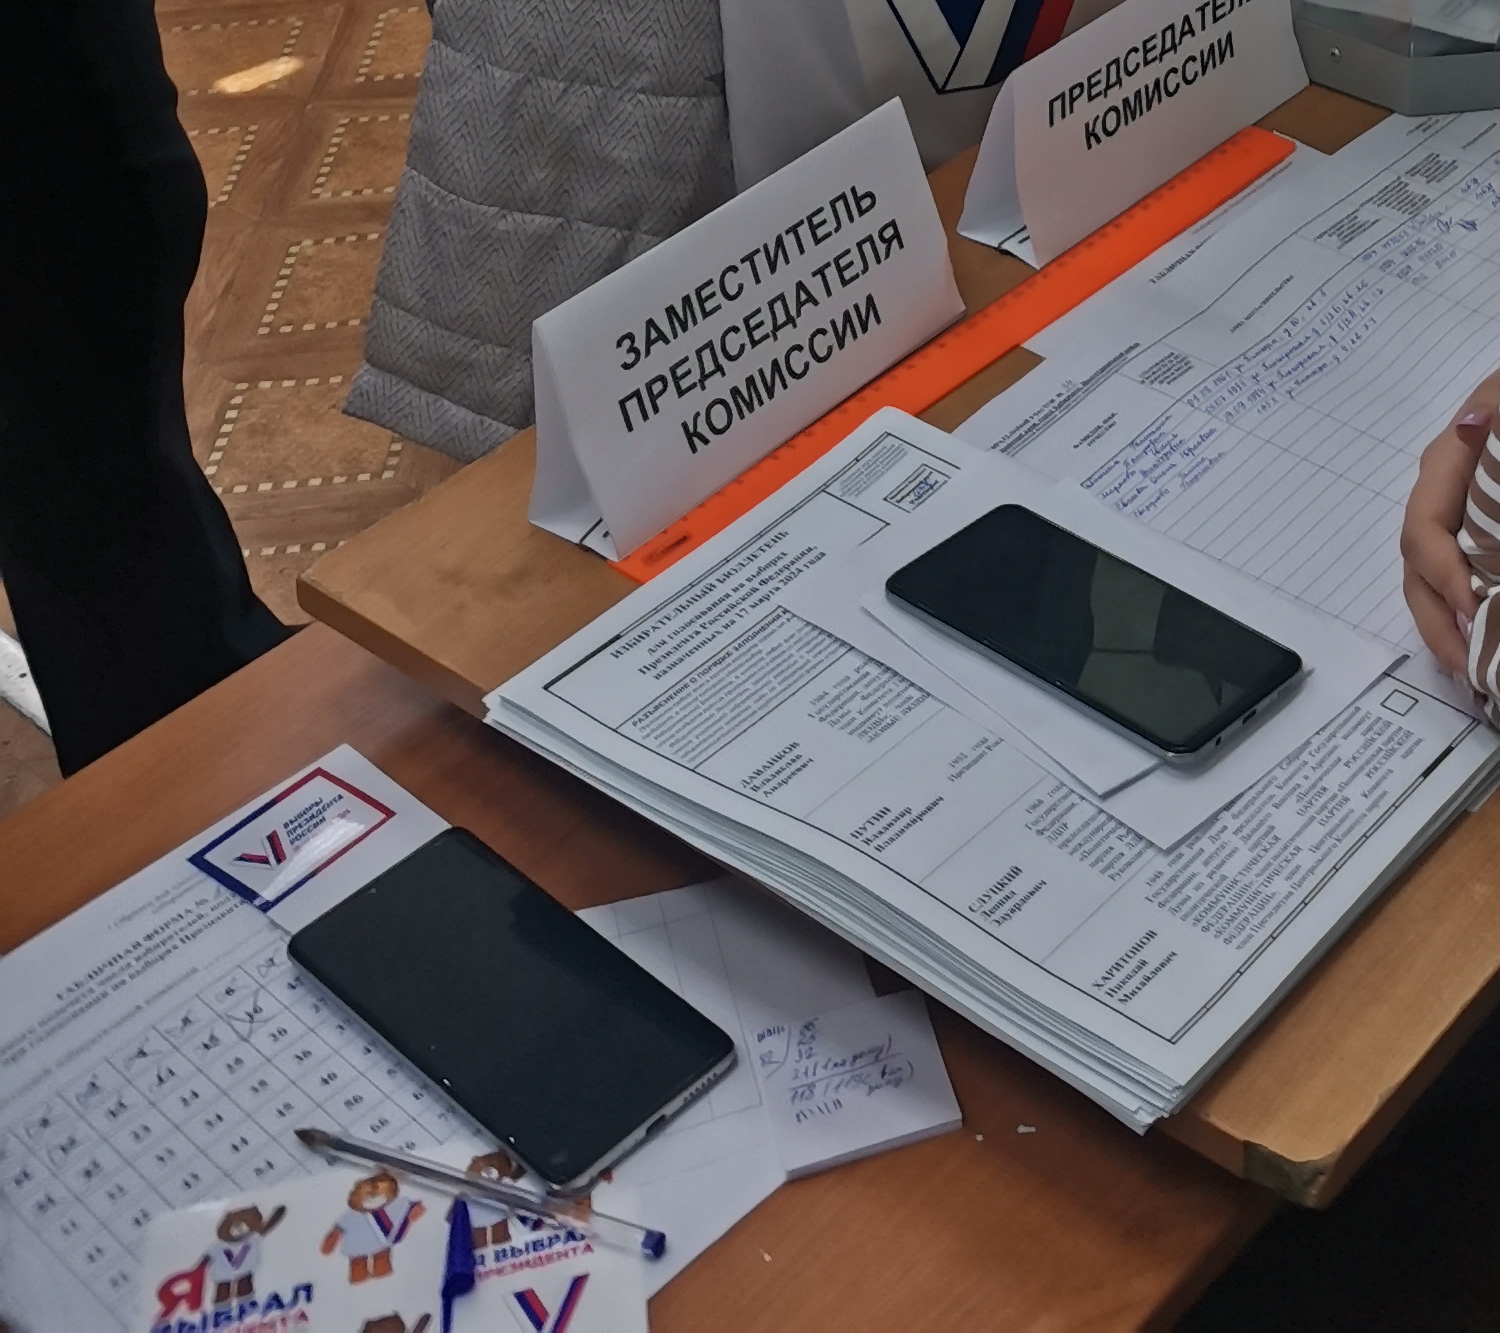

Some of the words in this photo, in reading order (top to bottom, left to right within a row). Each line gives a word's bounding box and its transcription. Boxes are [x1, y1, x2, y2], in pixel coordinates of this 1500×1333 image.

[1083, 31, 1237, 152] КОМИССИИ
[614, 183, 880, 372] ЗАМЕСТИТЕЛЬ
[618, 219, 906, 435] ПРЕДСЕДАТЕЛЯ
[680, 294, 883, 456] КОМИССИИ
[610, 580, 716, 659] ИЗБИРАТЕЛЬНЫЙ
[740, 740, 799, 787] ДАВАНКОВ
[282, 797, 322, 829] ВЫБОРЫ
[285, 793, 343, 837] ПРЕЗИДЕНТА
[288, 816, 326, 844] РОССИИ
[850, 805, 890, 840] ПУТИН
[968, 863, 1022, 914] СЛУЦКИЙ
[1091, 928, 1157, 991] ХАРИТОНОВ
[1105, 957, 1147, 998] Николай
[1118, 950, 1177, 1006] Михайлович
